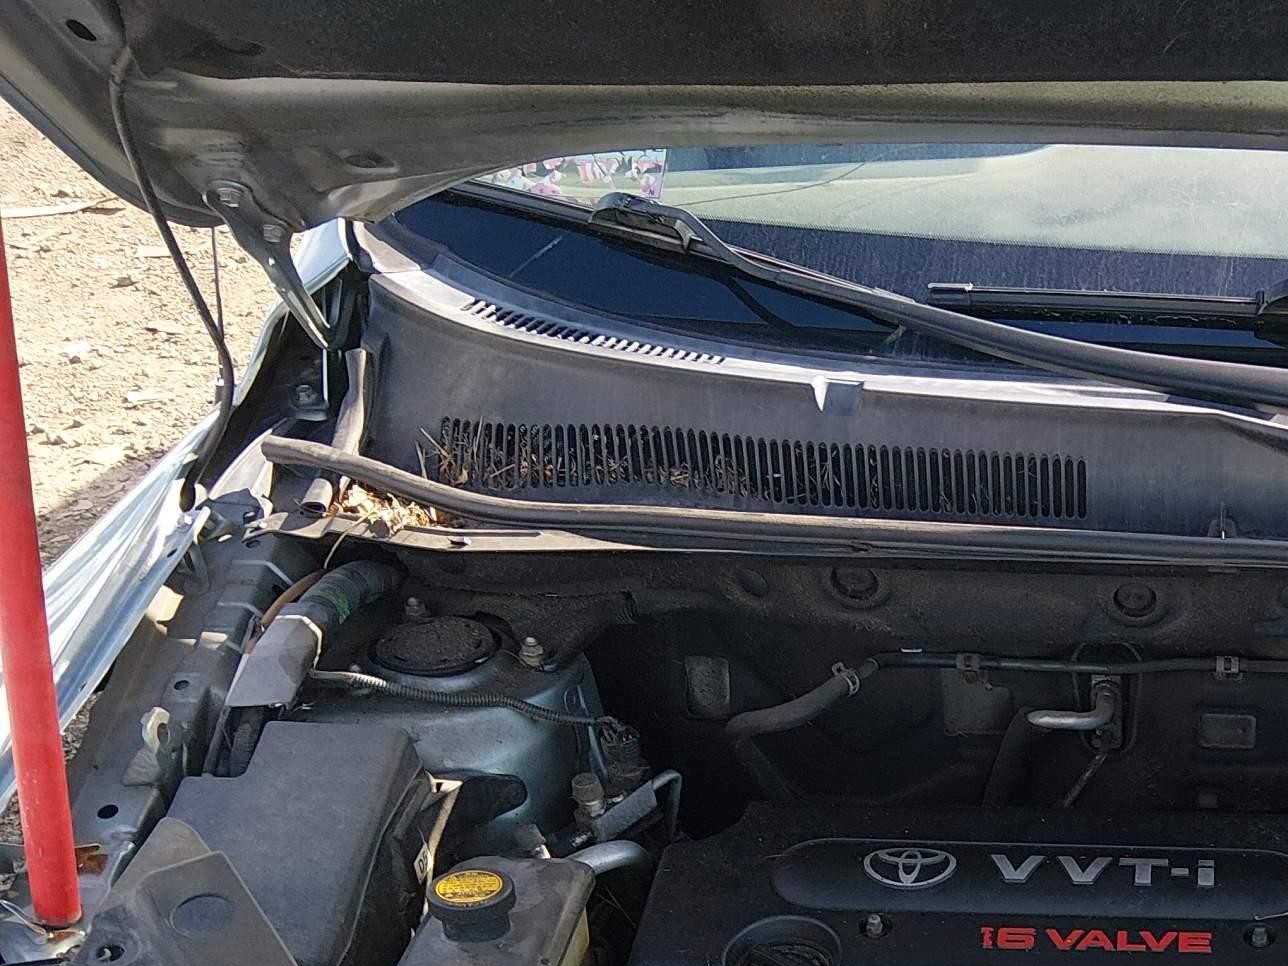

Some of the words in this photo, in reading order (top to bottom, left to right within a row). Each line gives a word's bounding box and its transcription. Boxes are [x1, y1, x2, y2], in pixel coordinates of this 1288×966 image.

[991, 854, 1215, 887] VVT-i
[980, 926, 1037, 950] 16
[1046, 928, 1213, 953] VALVE
